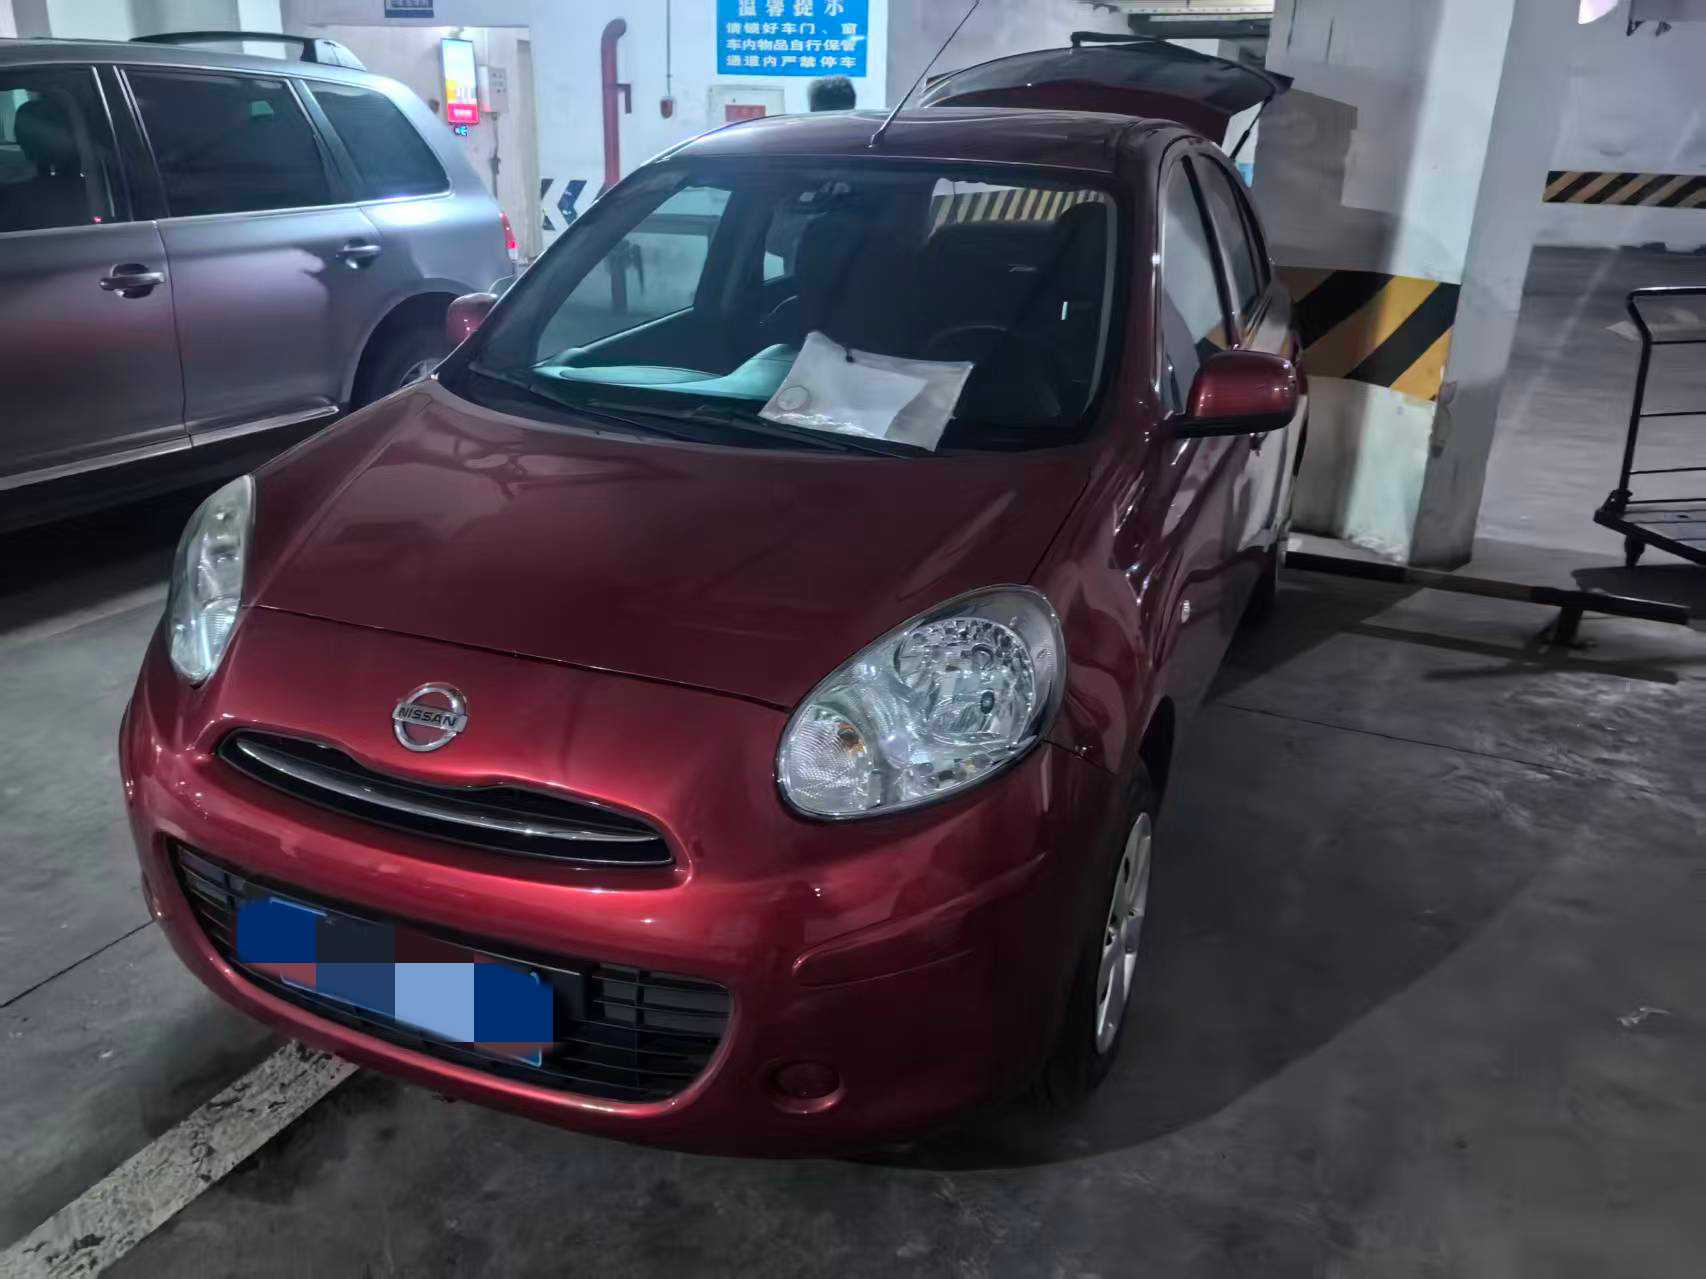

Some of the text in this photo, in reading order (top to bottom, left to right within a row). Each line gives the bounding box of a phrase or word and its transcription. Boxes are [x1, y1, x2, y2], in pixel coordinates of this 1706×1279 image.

[726, 39, 857, 52] 车内物品自行保管
[726, 55, 857, 68] 通道内严禁停车
[398, 707, 458, 727] NISSAN
